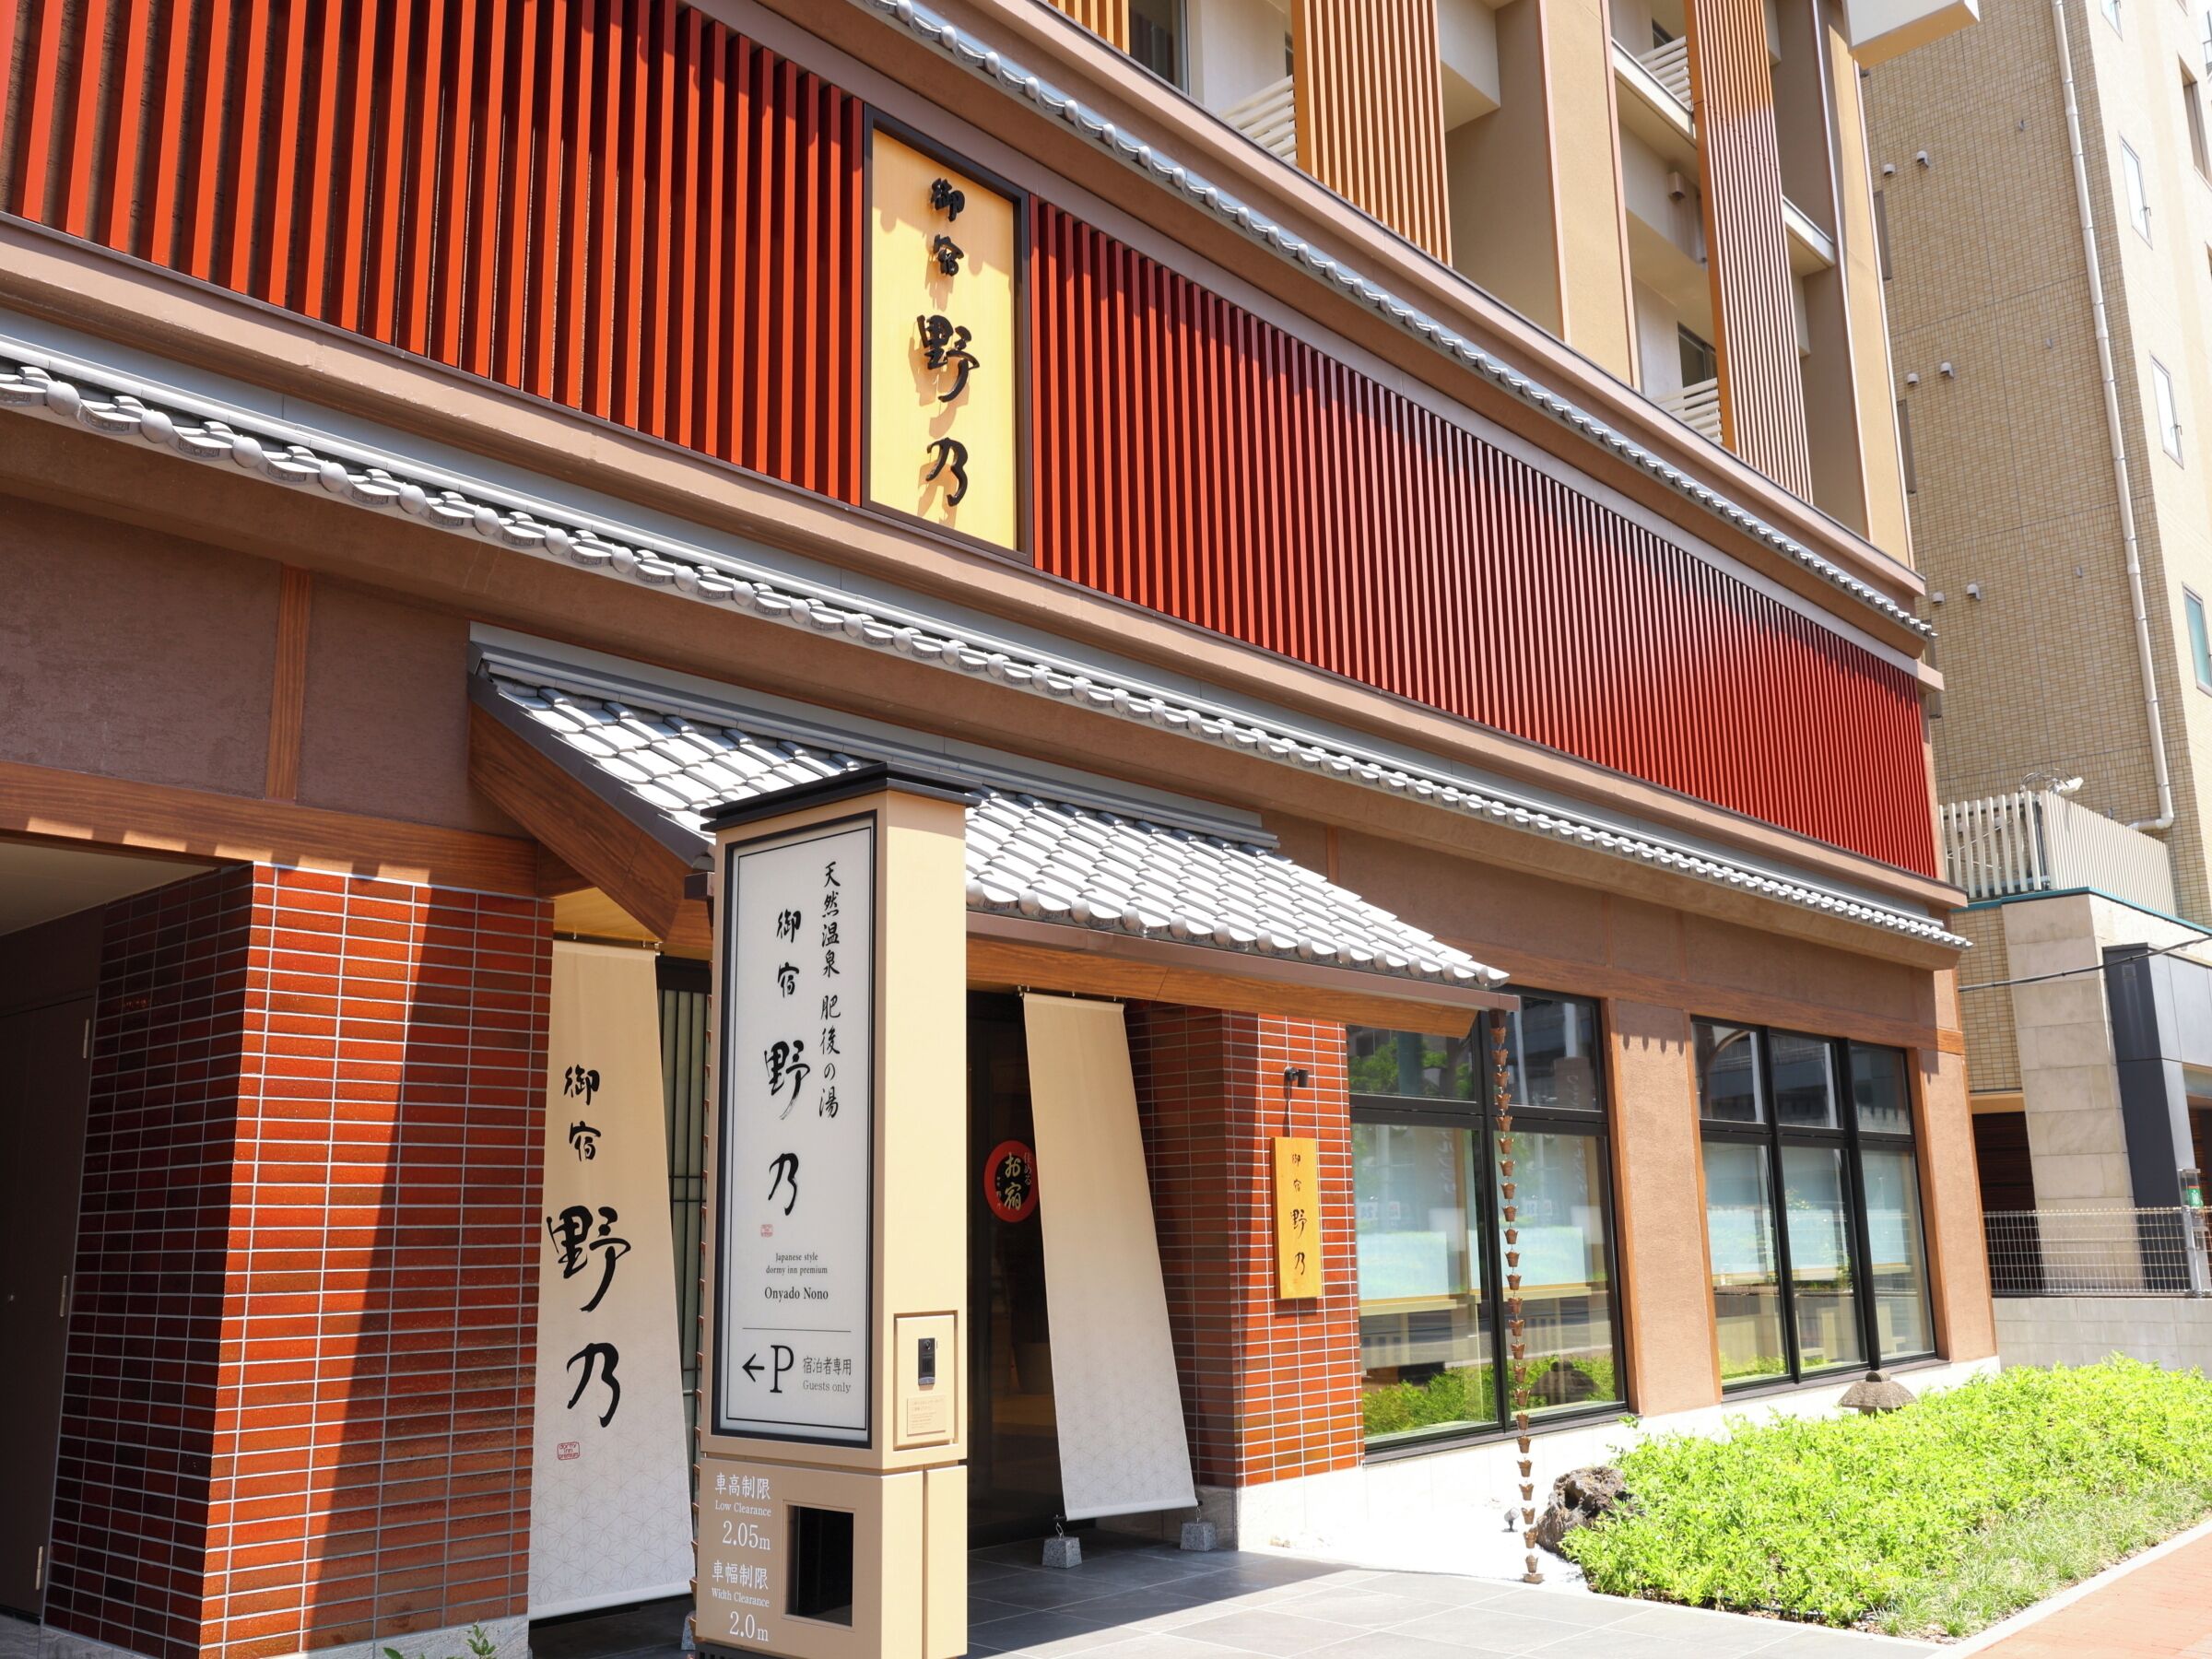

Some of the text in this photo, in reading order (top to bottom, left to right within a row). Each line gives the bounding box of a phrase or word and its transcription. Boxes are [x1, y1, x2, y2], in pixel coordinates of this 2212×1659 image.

[819, 861, 841, 1118] 天然温泉 肥後の湯
[776, 1252, 818, 1264] Japanese style
[765, 1265, 785, 1276] dormy
[800, 1267, 828, 1277] premium
[764, 1287, 829, 1302] Onyado Nono
[770, 1345, 794, 1394] P
[803, 1356, 852, 1375] 宿泊者専用
[803, 1380, 852, 1394] Guests only
[715, 1472, 771, 1500] 車高制限
[715, 1500, 771, 1516] Low Clearance
[722, 1520, 771, 1550] 2.05m
[712, 1559, 769, 1590] 車幅制限
[712, 1587, 770, 1607] Width Clearance
